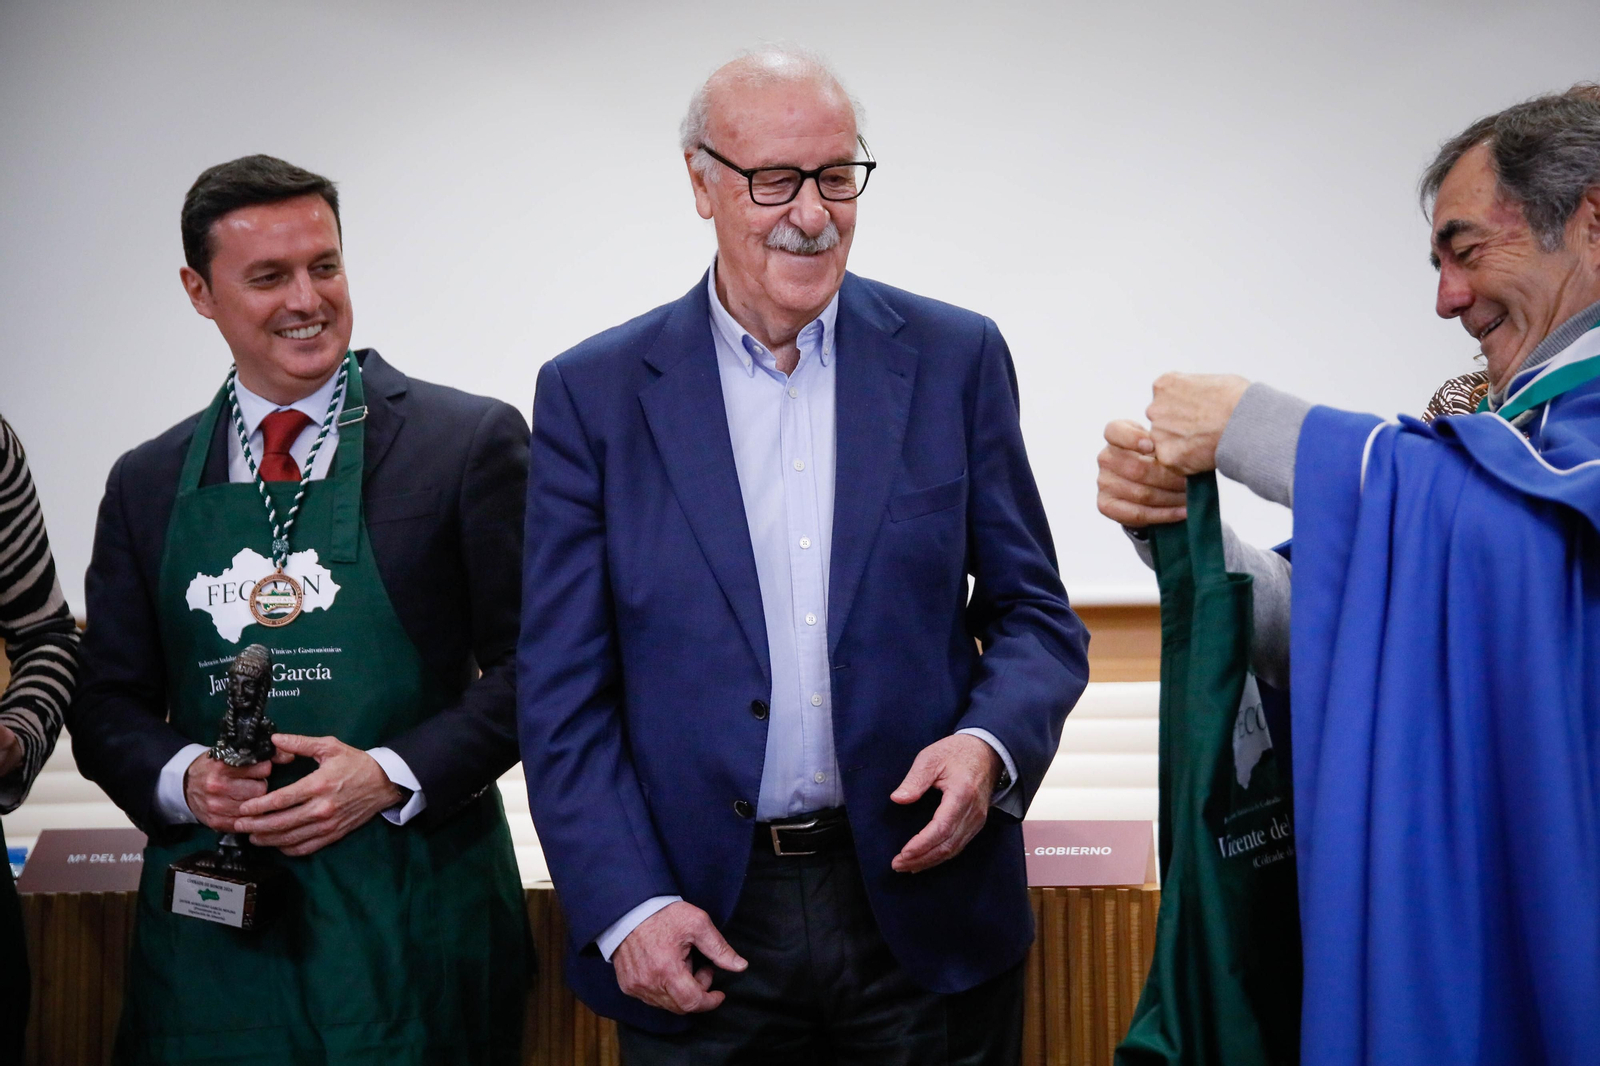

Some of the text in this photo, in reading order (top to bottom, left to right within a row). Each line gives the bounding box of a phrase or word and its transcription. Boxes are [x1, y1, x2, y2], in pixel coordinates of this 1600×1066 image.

[209, 663, 332, 697] Javi García
[1034, 846, 1112, 856] GOBIERNO
[1218, 829, 1267, 858] Vicente
[89, 853, 117, 863] DEL
[120, 853, 144, 863] MA
